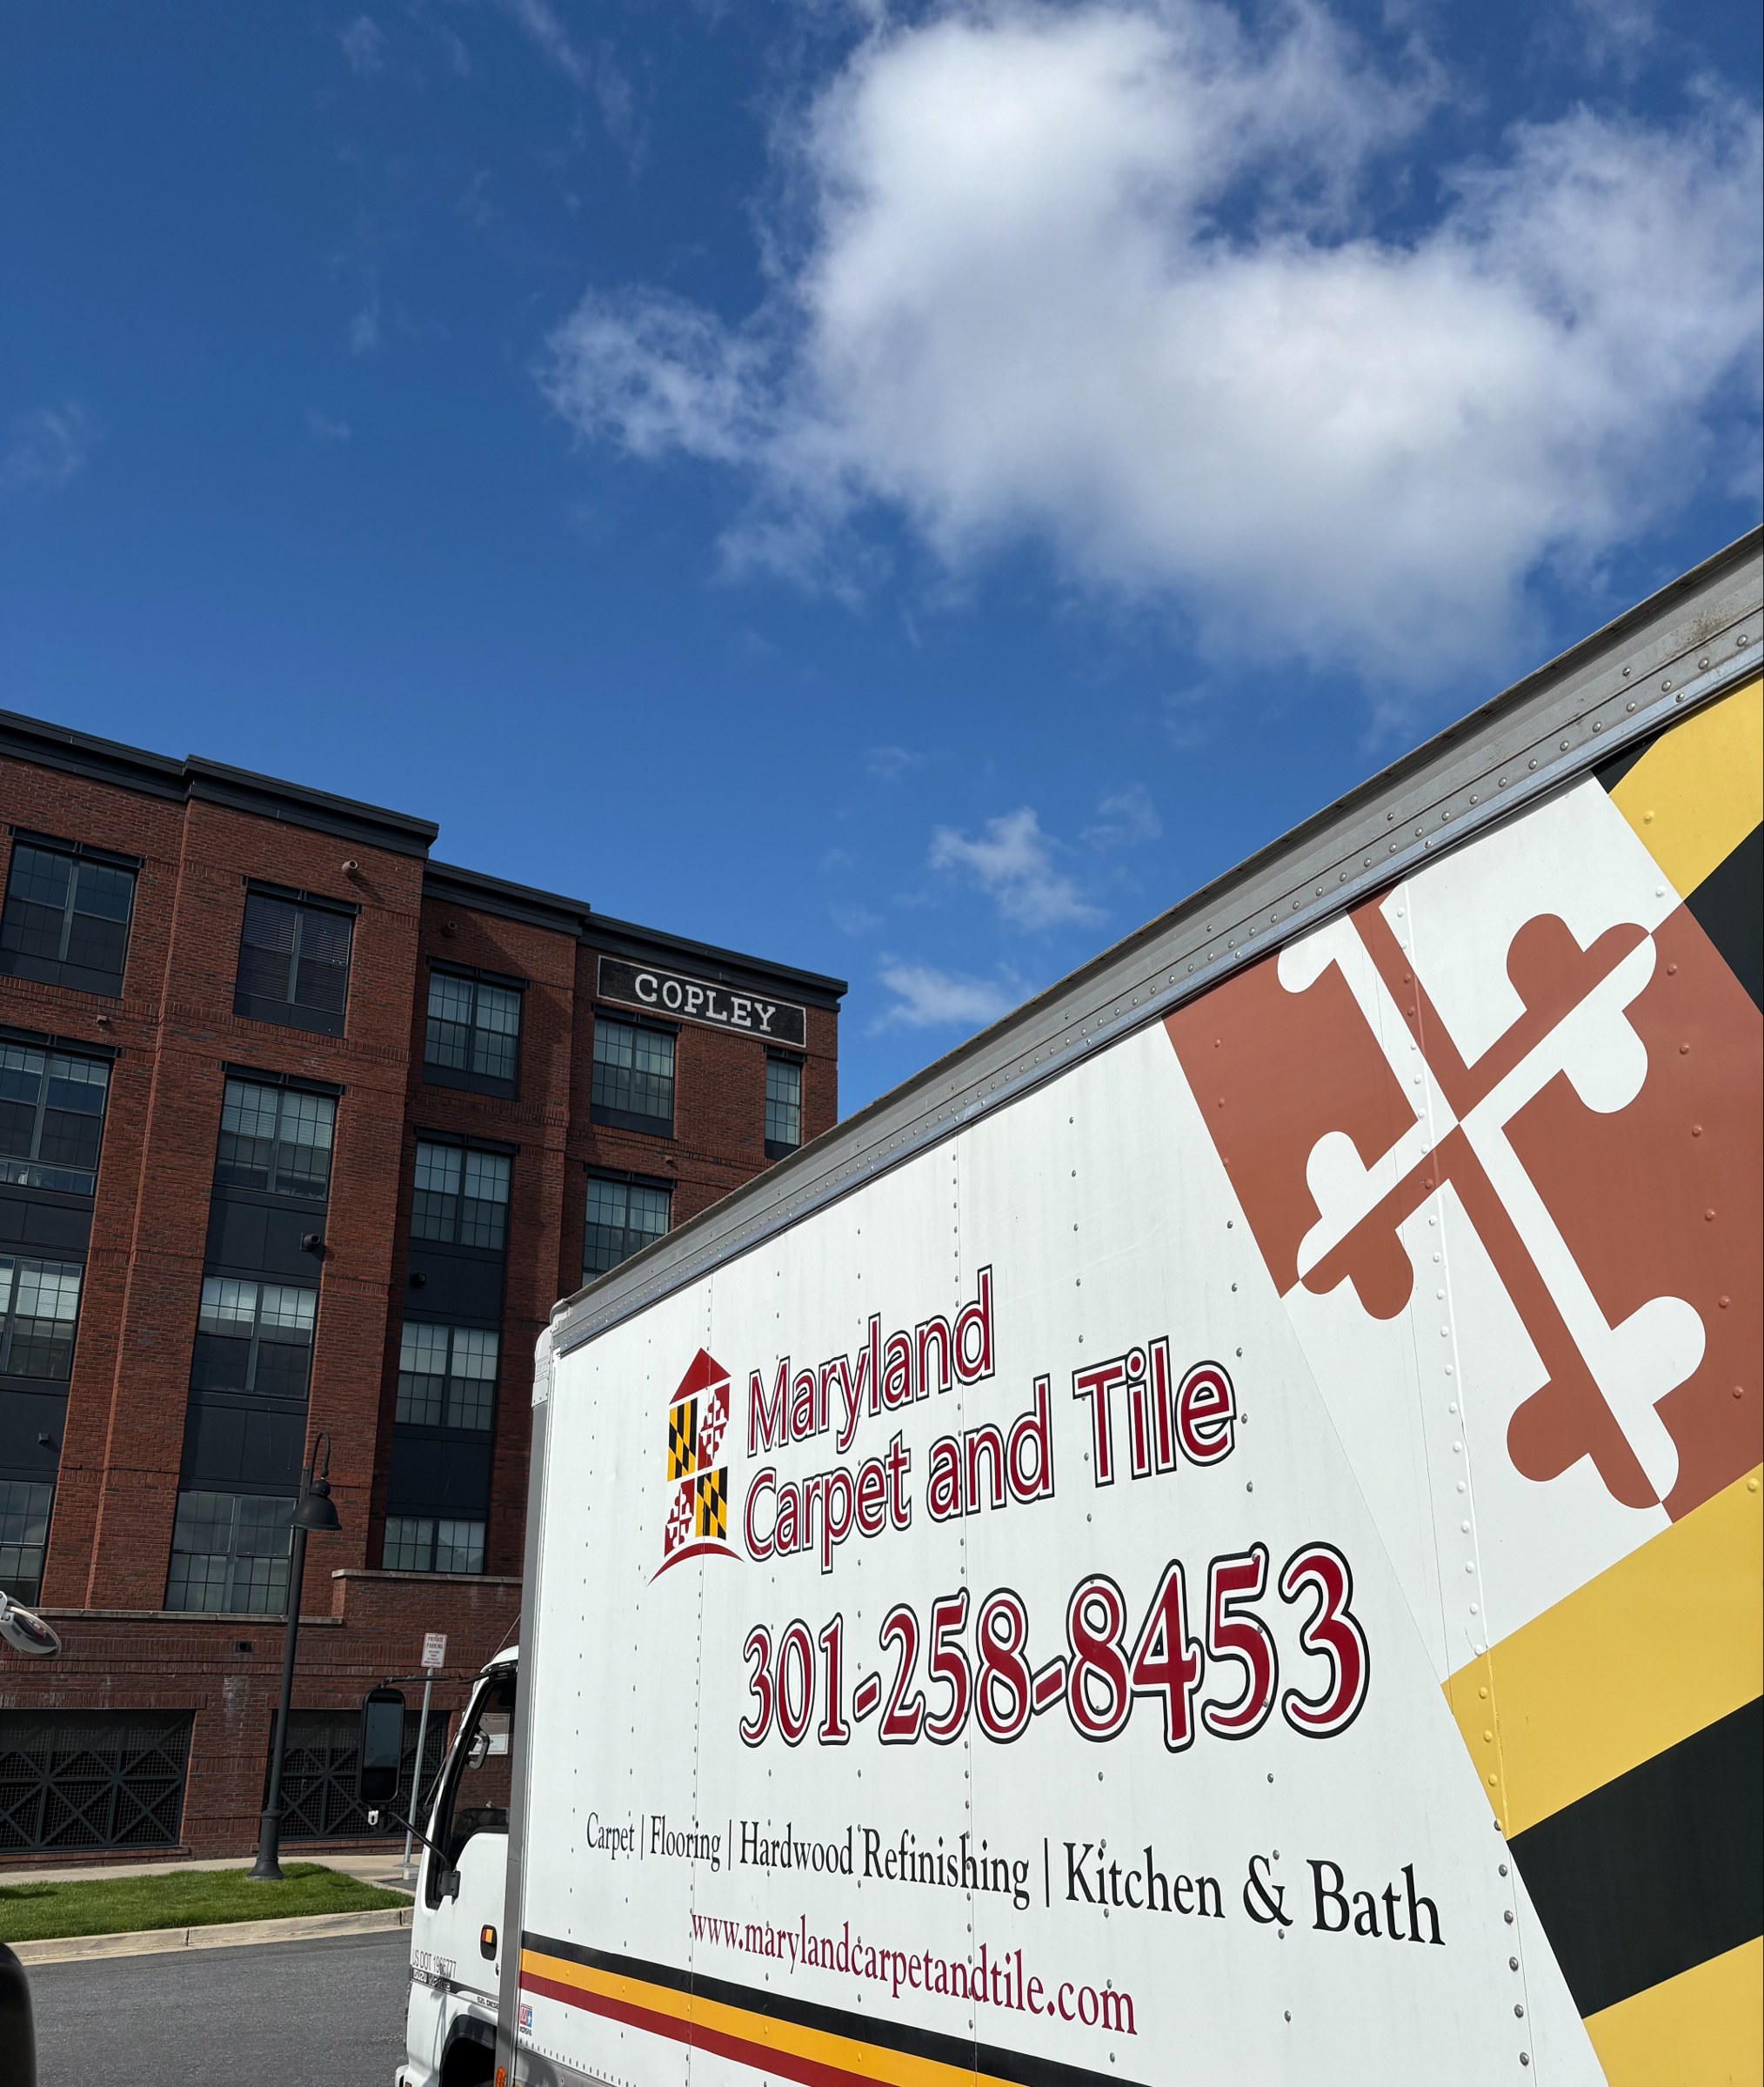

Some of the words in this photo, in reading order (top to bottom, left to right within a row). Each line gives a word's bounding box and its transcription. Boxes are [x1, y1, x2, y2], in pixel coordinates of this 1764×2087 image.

[635, 973, 776, 1033] COPLEY
[746, 1264, 995, 1458] Maryland
[744, 1429, 912, 1575] Carpet
[926, 1373, 1054, 1523] and
[1072, 1335, 1237, 1488] Tile
[739, 1542, 1370, 1754] 301-258-8453
[586, 1812, 635, 1860] Carpet
[650, 1814, 721, 1872] Flooring
[739, 1821, 854, 1875] Hardwood
[862, 1828, 1030, 1910] Refinishing
[1063, 1844, 1226, 1919] Kitchen
[1243, 1854, 1293, 1926] &
[1306, 1859, 1446, 1946] Bath
[420, 1950, 432, 1970] DOT
[692, 1913, 1138, 2036] www.marylandcarpetandtile.com
